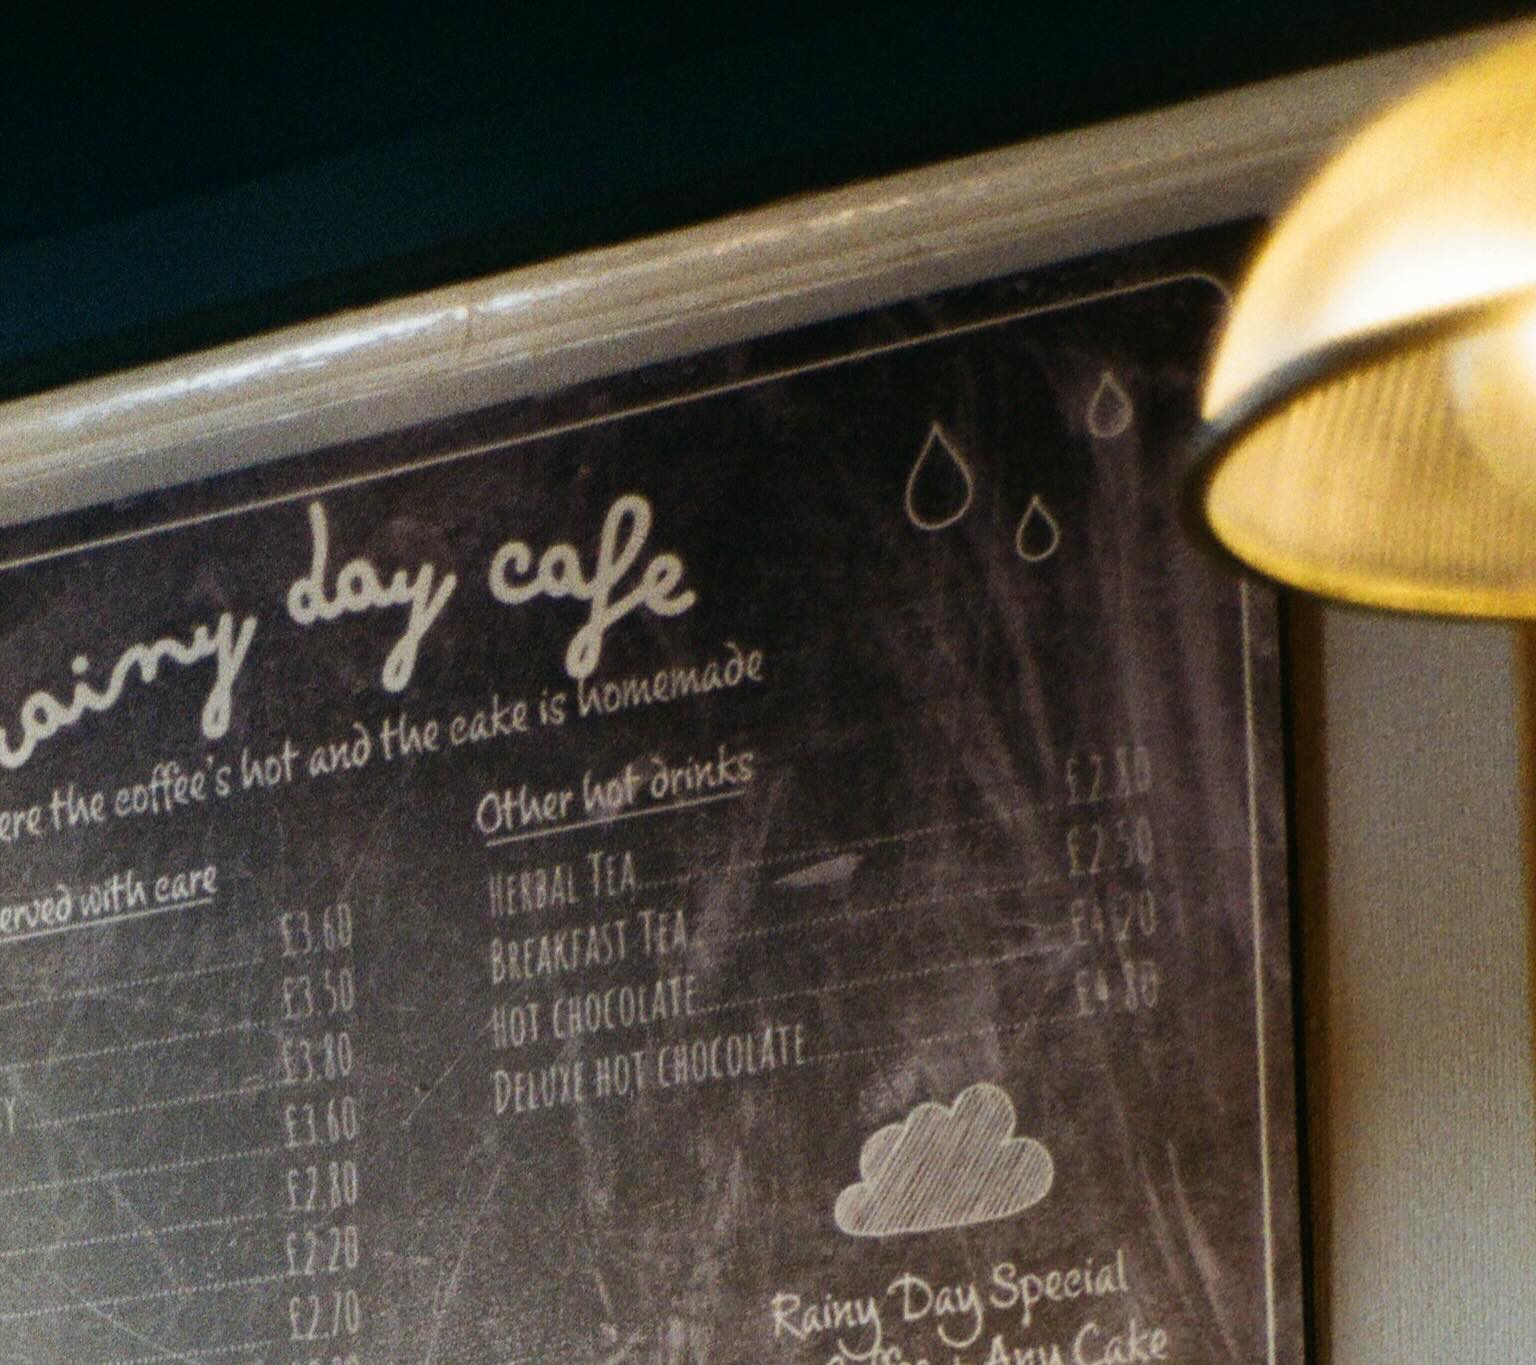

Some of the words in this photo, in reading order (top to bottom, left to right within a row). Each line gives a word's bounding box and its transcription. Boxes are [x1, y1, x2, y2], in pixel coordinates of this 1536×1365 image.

[286, 501, 457, 693] day
[488, 495, 696, 679] cafe
[50, 785, 106, 830] the
[115, 755, 232, 818] coffee's
[241, 740, 300, 790] hot
[310, 721, 371, 777] and
[380, 713, 440, 760] the
[450, 693, 528, 744] cake
[540, 688, 566, 726] is
[578, 641, 763, 718] homemade
[476, 782, 573, 833] Other
[583, 765, 641, 810] hot
[651, 745, 755, 798] drinks
[80, 867, 146, 918] with
[156, 863, 218, 903] care
[490, 865, 578, 918] HERBAL
[588, 849, 637, 897] TEA
[281, 903, 353, 957] £3.60
[491, 919, 626, 985] BREAKFAST
[639, 908, 688, 955] TEA
[282, 968, 355, 1020] £3.50
[492, 1003, 539, 1049] HOT
[553, 975, 698, 1041] CHOCOLATE
[495, 1061, 585, 1115] DELUXE
[596, 1050, 645, 1098] HOT
[659, 1023, 806, 1088] CHOCOLATE
[772, 1292, 882, 1361] Rainy
[887, 1273, 984, 1348] Day
[990, 1249, 1129, 1327] Special
